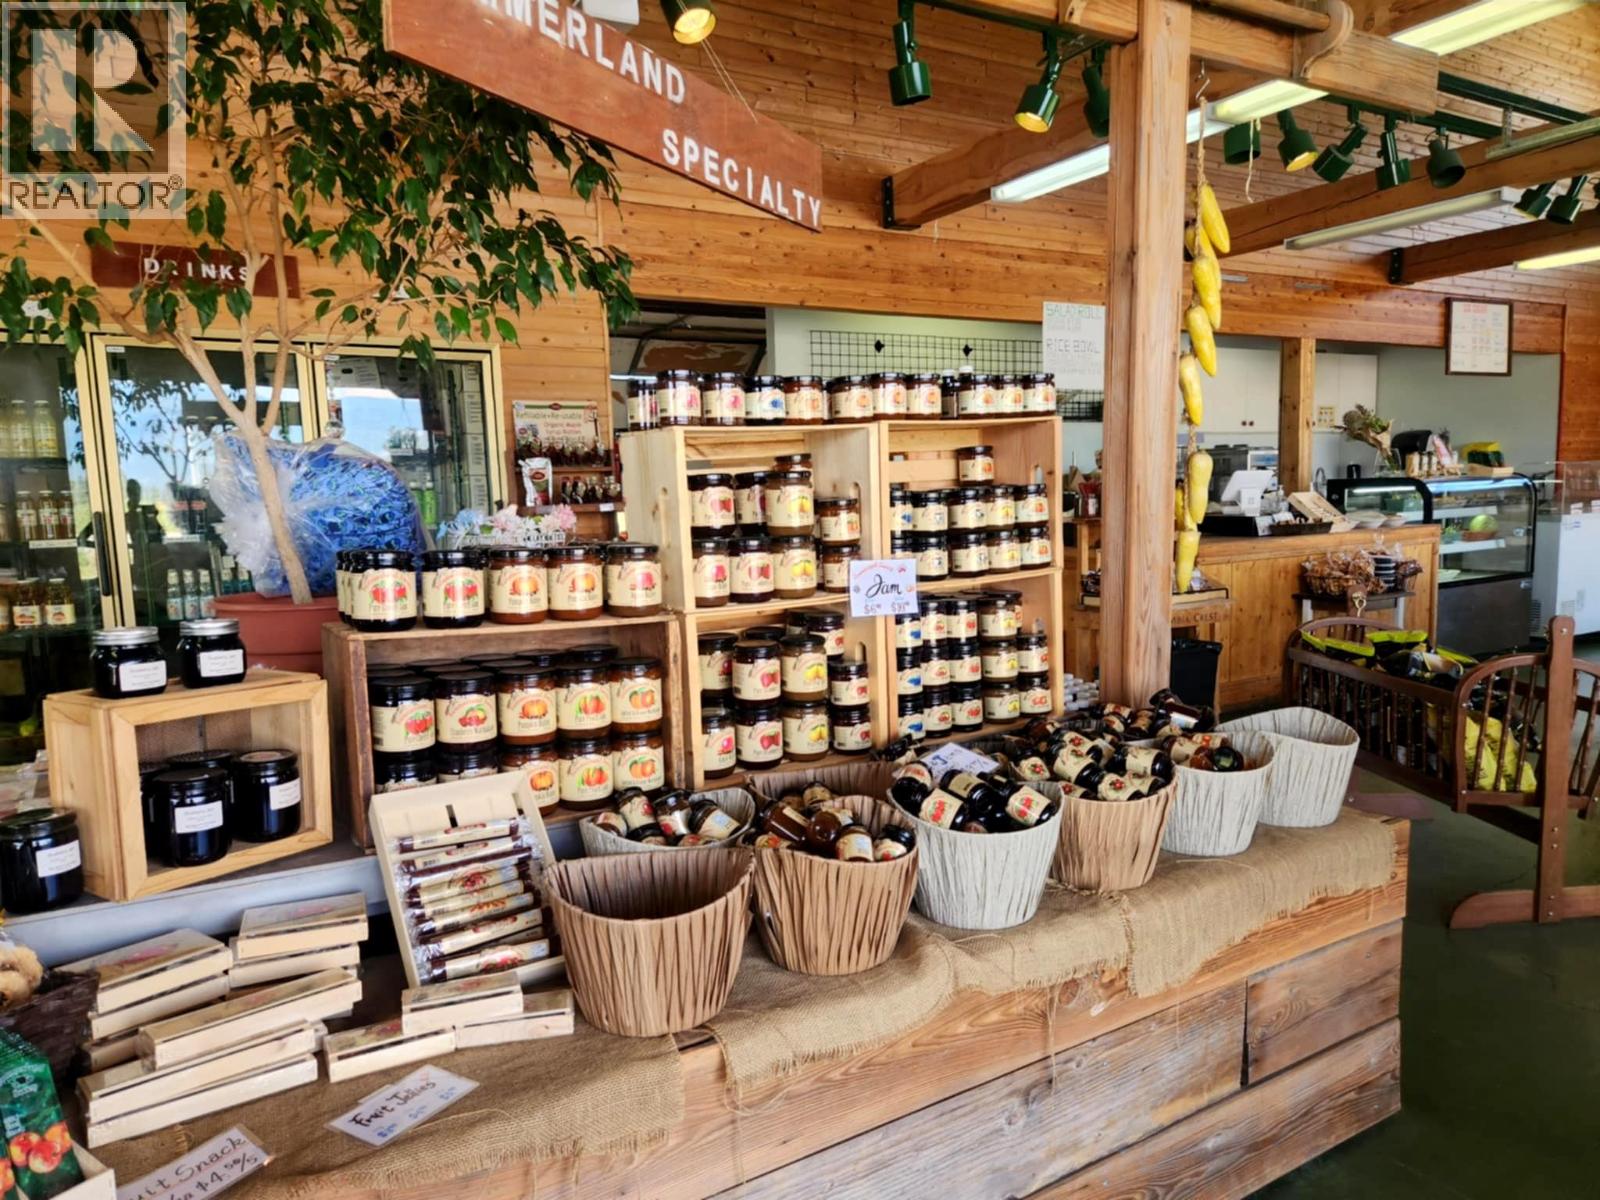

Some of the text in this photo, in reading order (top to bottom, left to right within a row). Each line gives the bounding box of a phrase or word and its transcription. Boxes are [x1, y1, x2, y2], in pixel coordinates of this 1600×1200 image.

[662, 128, 821, 227] SPECIALTY
[865, 573, 902, 598] Jam
[348, 1104, 395, 1127] Fruit
[175, 1137, 247, 1182] Snack
